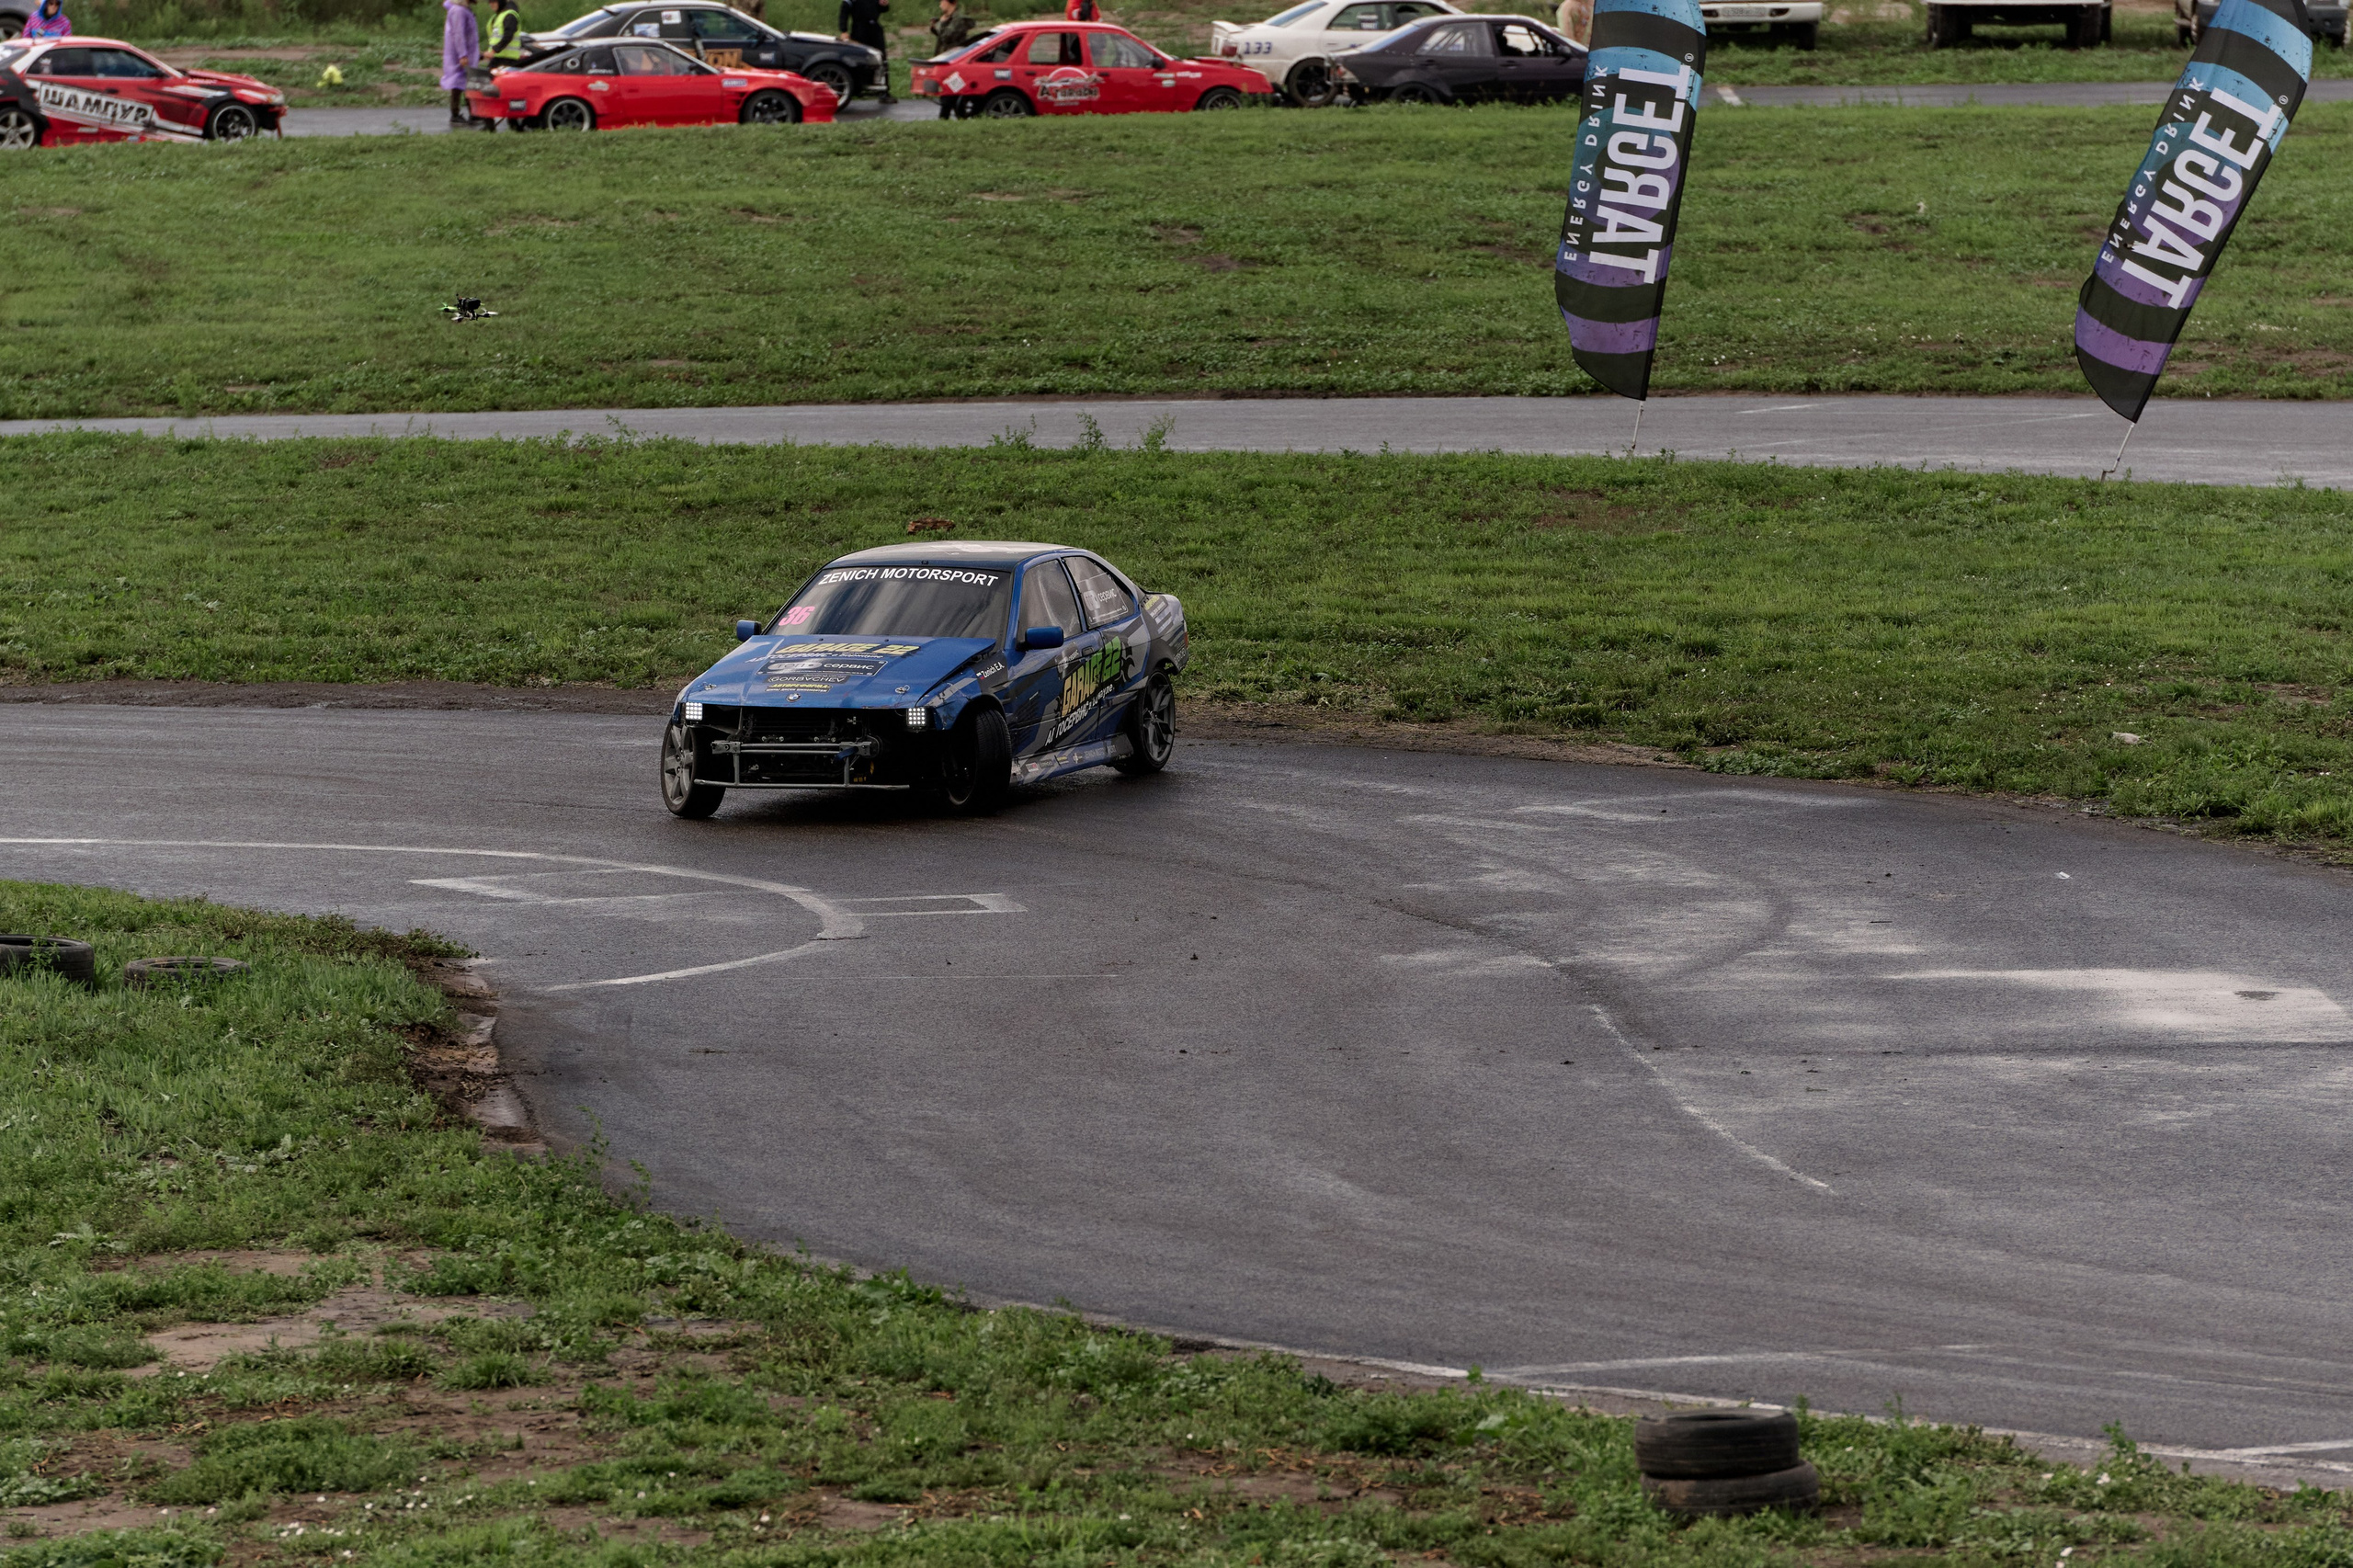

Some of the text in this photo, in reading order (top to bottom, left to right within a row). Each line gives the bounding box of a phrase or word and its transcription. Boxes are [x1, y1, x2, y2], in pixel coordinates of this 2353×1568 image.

[1244, 41, 1272, 54] 133
[45, 88, 150, 121] ШАМПУР
[818, 567, 999, 586] ZENICH MOTORSPORT
[779, 606, 815, 626] 36
[775, 642, 881, 653] GARAGE
[872, 644, 920, 655] 22
[824, 663, 874, 672] сервис
